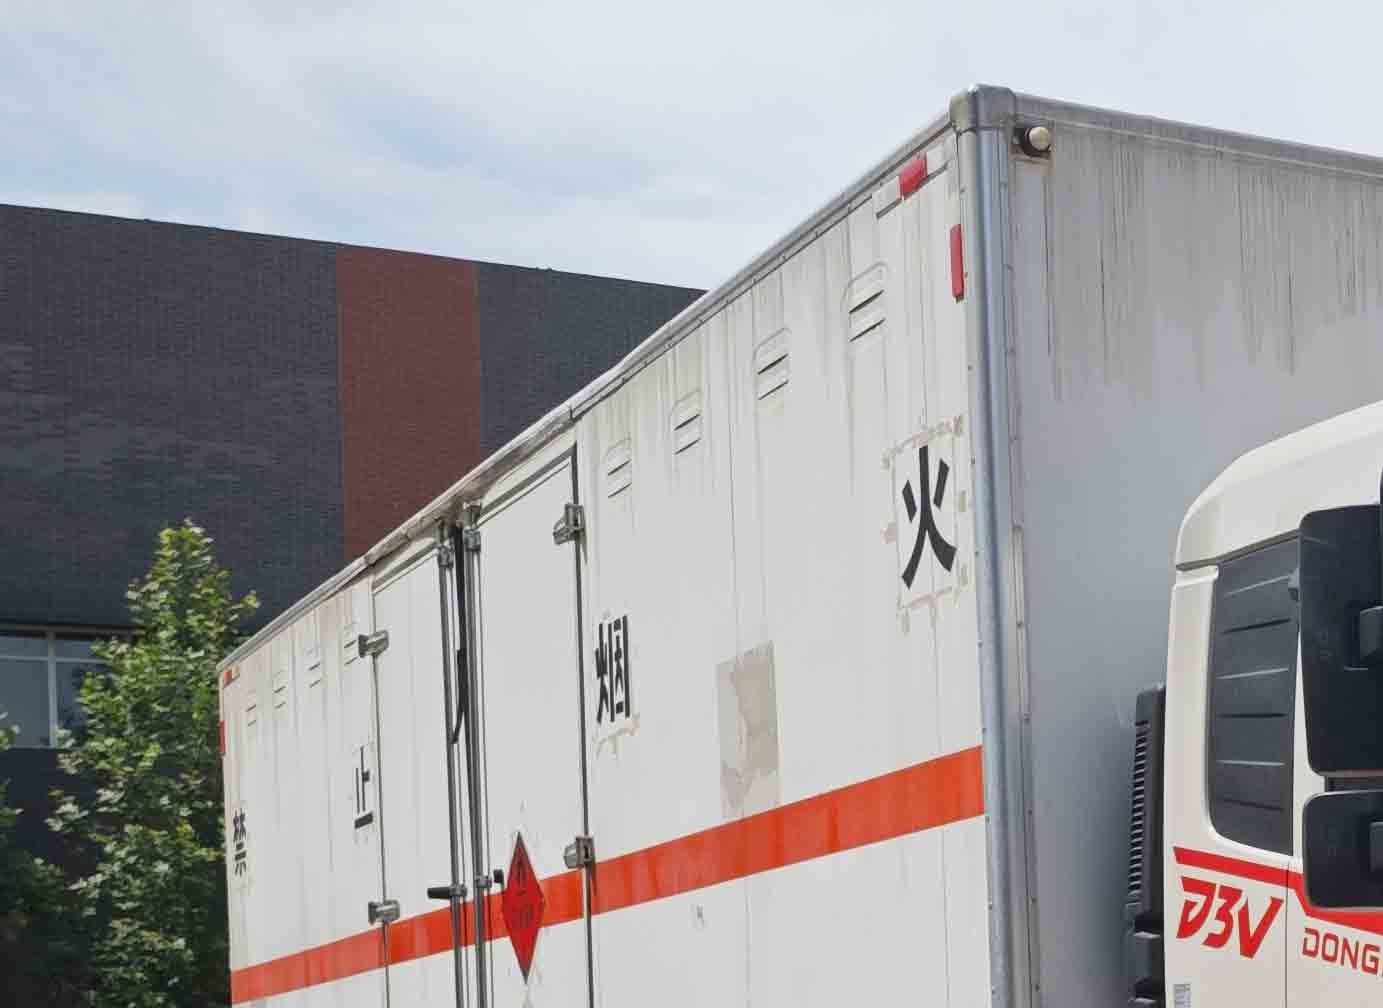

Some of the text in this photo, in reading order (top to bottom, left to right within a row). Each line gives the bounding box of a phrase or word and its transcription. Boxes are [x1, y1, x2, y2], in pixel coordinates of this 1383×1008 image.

[232, 444, 958, 877] 禁 止 烟 火
[1176, 876, 1284, 959] D3V
